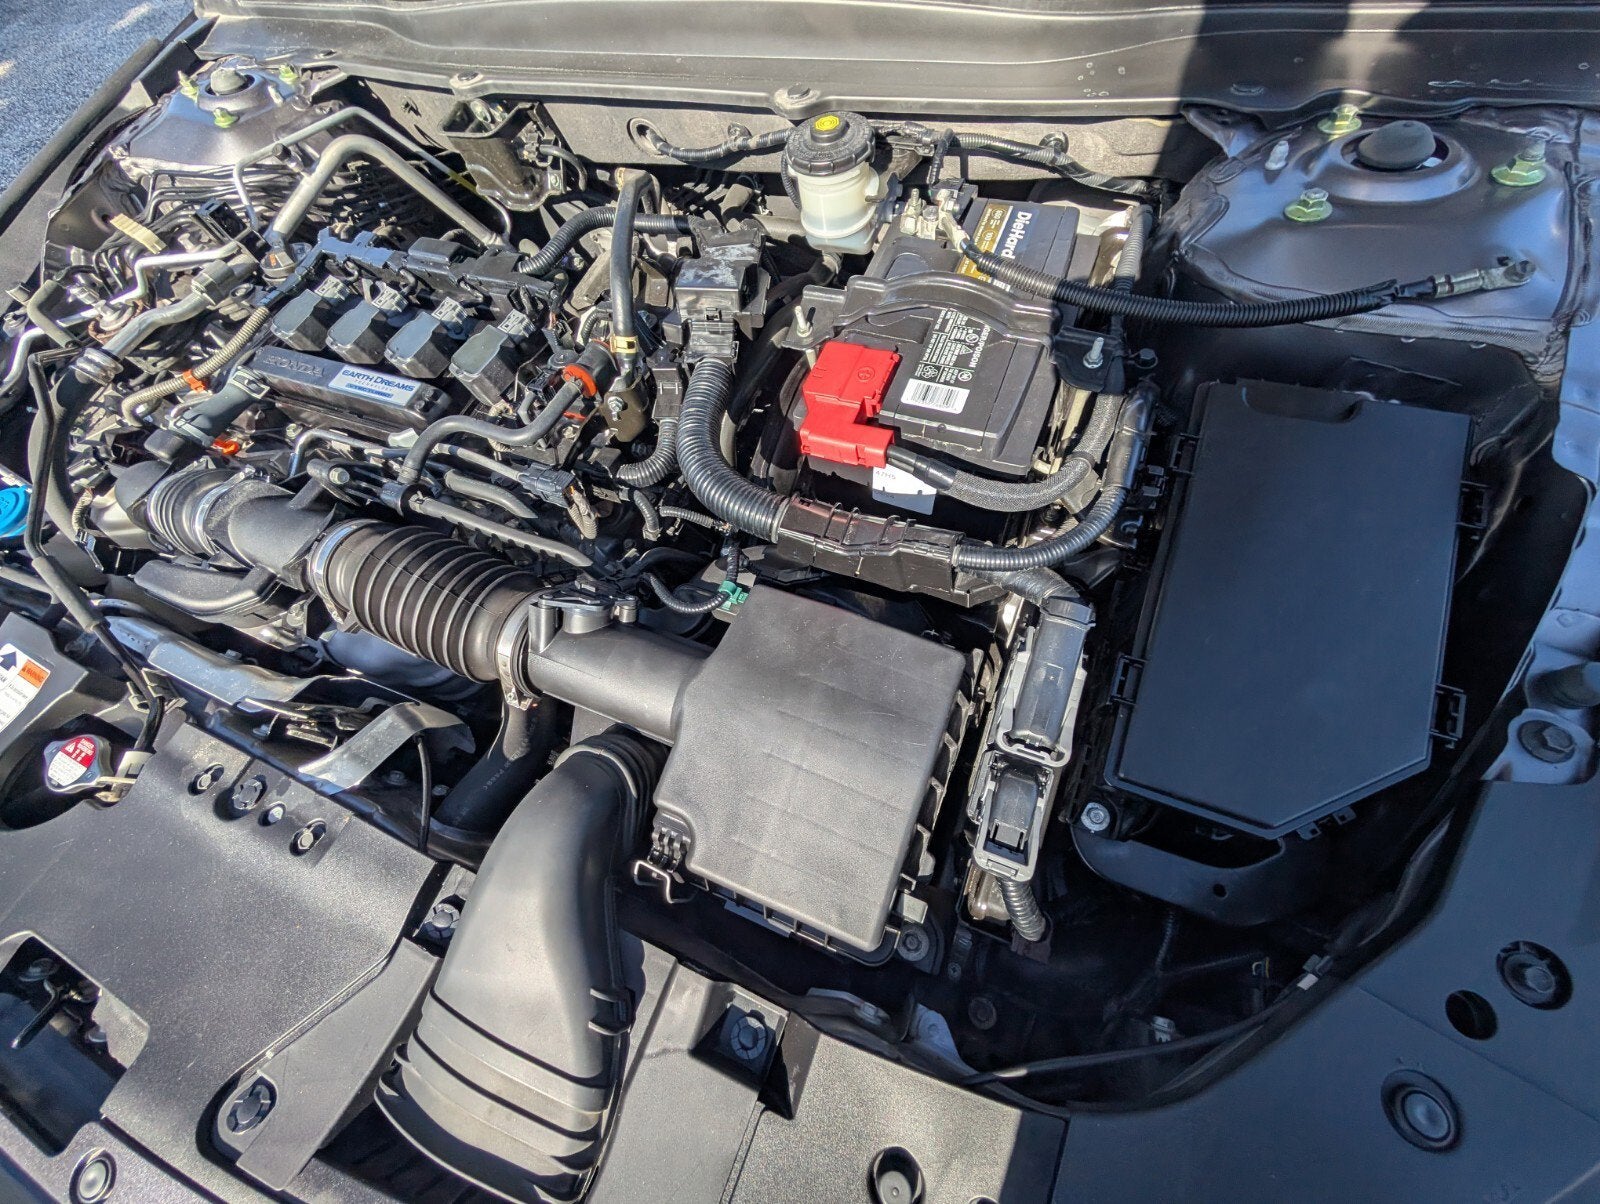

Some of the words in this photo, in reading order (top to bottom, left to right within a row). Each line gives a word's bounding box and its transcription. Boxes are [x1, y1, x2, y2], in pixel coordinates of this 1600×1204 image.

[1001, 211, 1032, 259] DieHard
[968, 324, 991, 367] GER/POISON
[264, 355, 325, 377] HONDA
[342, 369, 374, 382] EARTH
[374, 376, 415, 392] DREAMS
